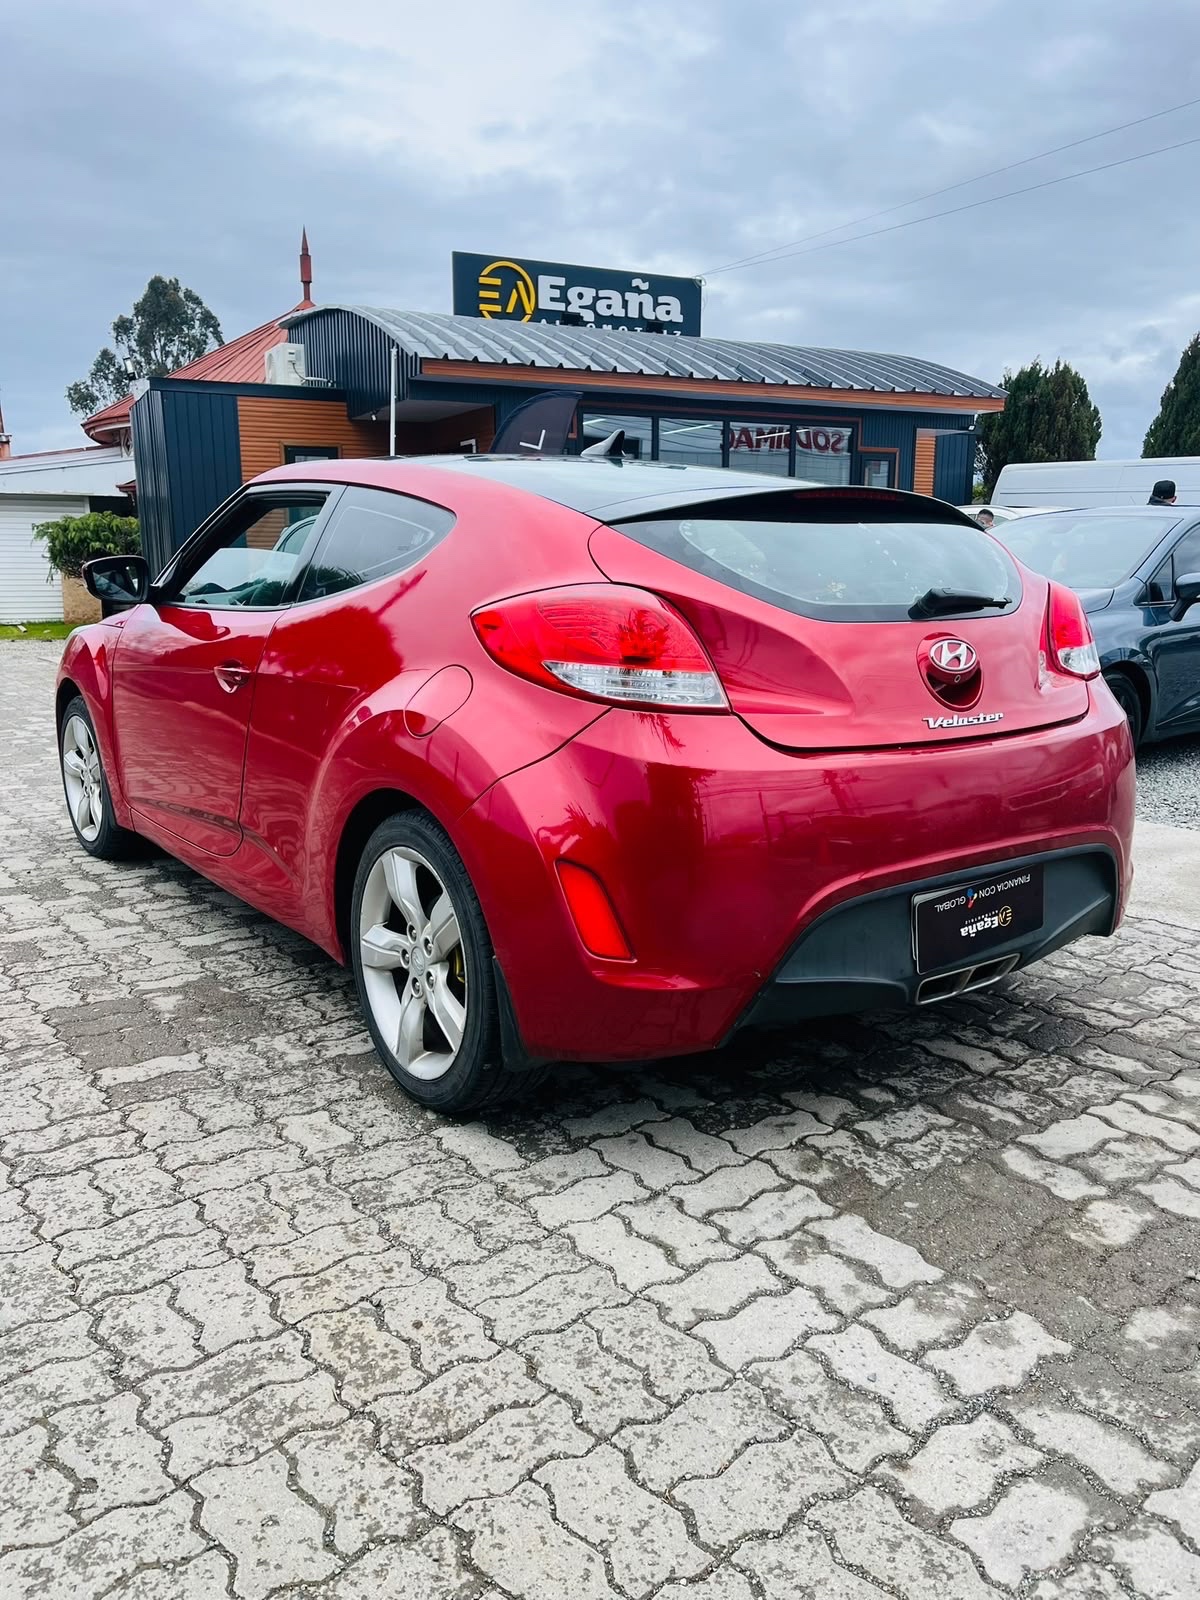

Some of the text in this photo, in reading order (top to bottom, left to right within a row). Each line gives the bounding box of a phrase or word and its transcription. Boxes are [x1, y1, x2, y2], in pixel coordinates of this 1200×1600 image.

[538, 275, 684, 323] Egaña
[922, 712, 1004, 729] Veloster
[934, 873, 1031, 912] FINANCIA CON GLOBAL
[960, 915, 999, 937] Egaña
